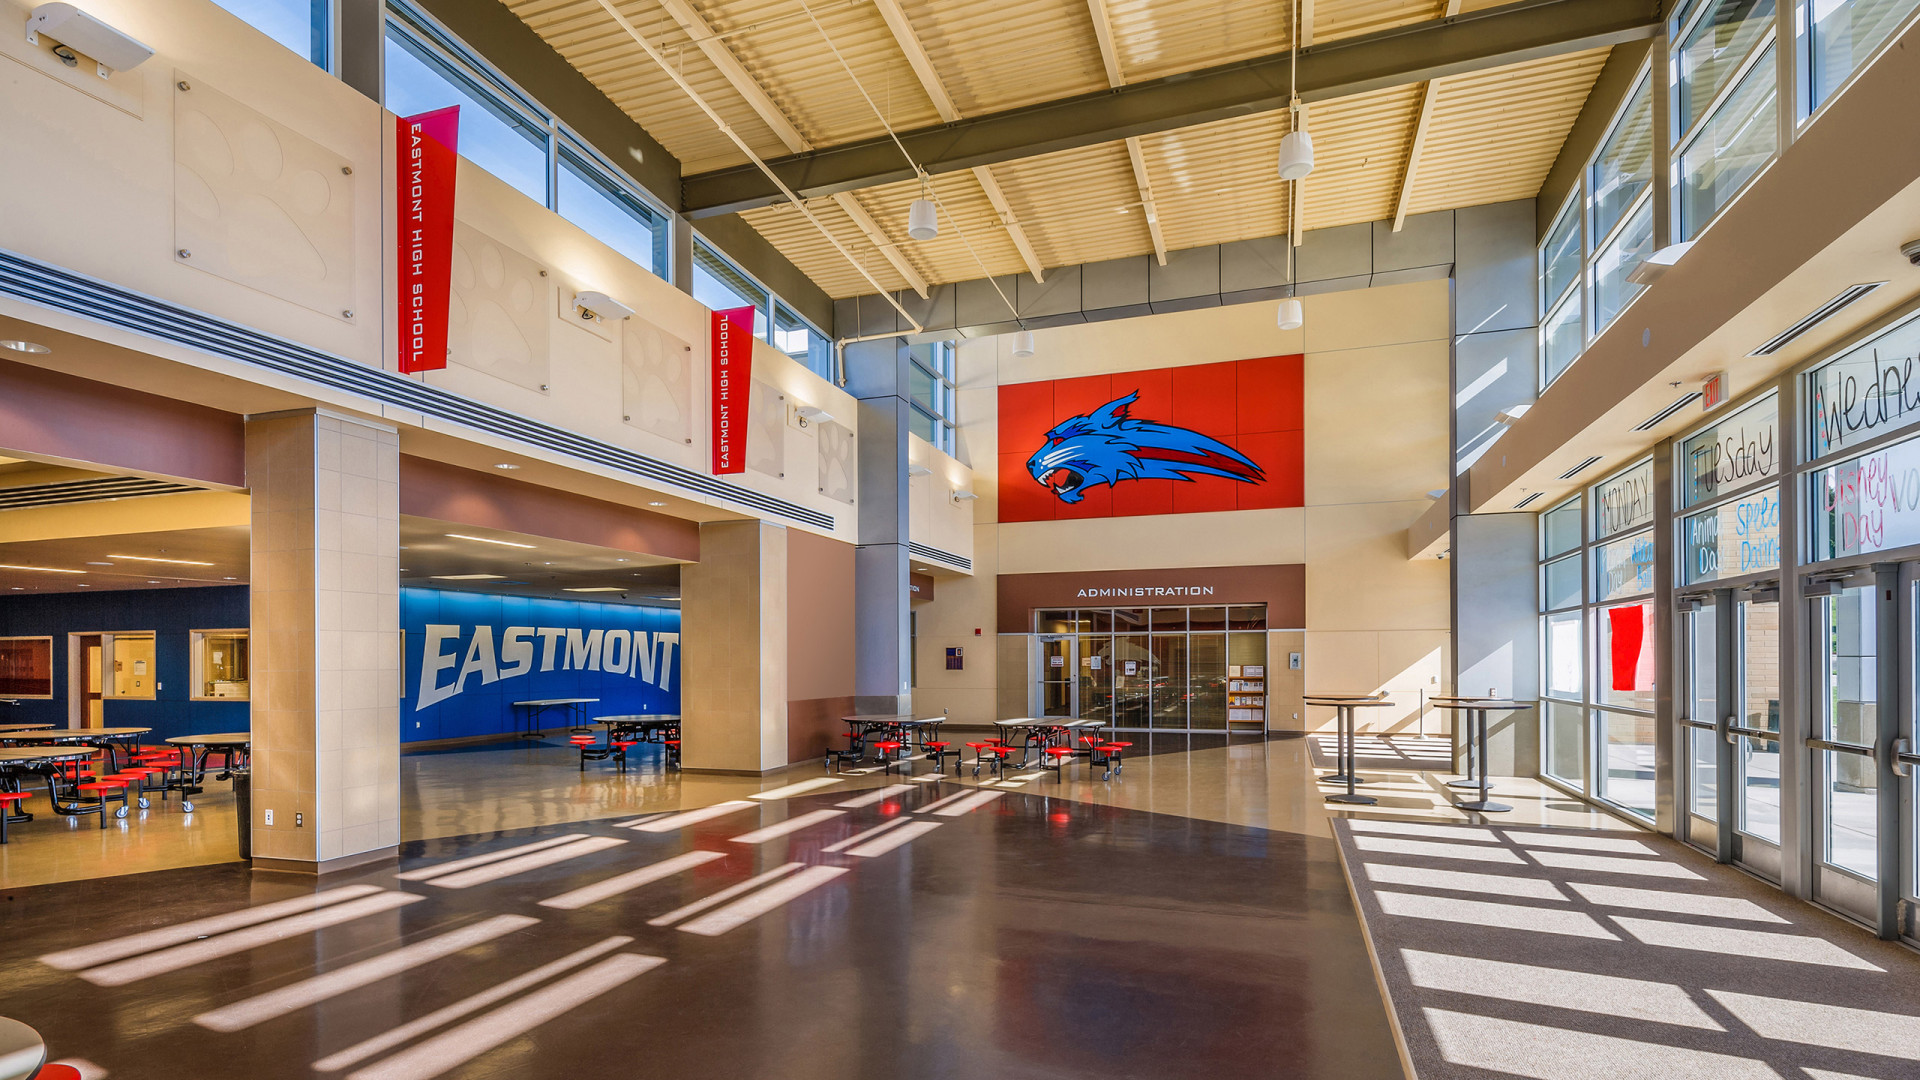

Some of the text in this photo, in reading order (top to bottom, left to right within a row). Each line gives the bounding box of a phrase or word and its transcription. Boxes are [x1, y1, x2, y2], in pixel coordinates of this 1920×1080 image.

[411, 123, 423, 362] EASTMONT HIGH SCHOOL
[720, 315, 729, 468] EASTMONT HIGH SCHOOL
[1705, 377, 1719, 407] EXIT
[1690, 425, 1773, 501] Tuesday
[1823, 452, 1888, 513] Disney
[1603, 469, 1649, 535] MONDAY
[1841, 508, 1884, 553] Day
[1077, 586, 1214, 598] ADMINISTRATION
[415, 623, 680, 712] EASTMONT
